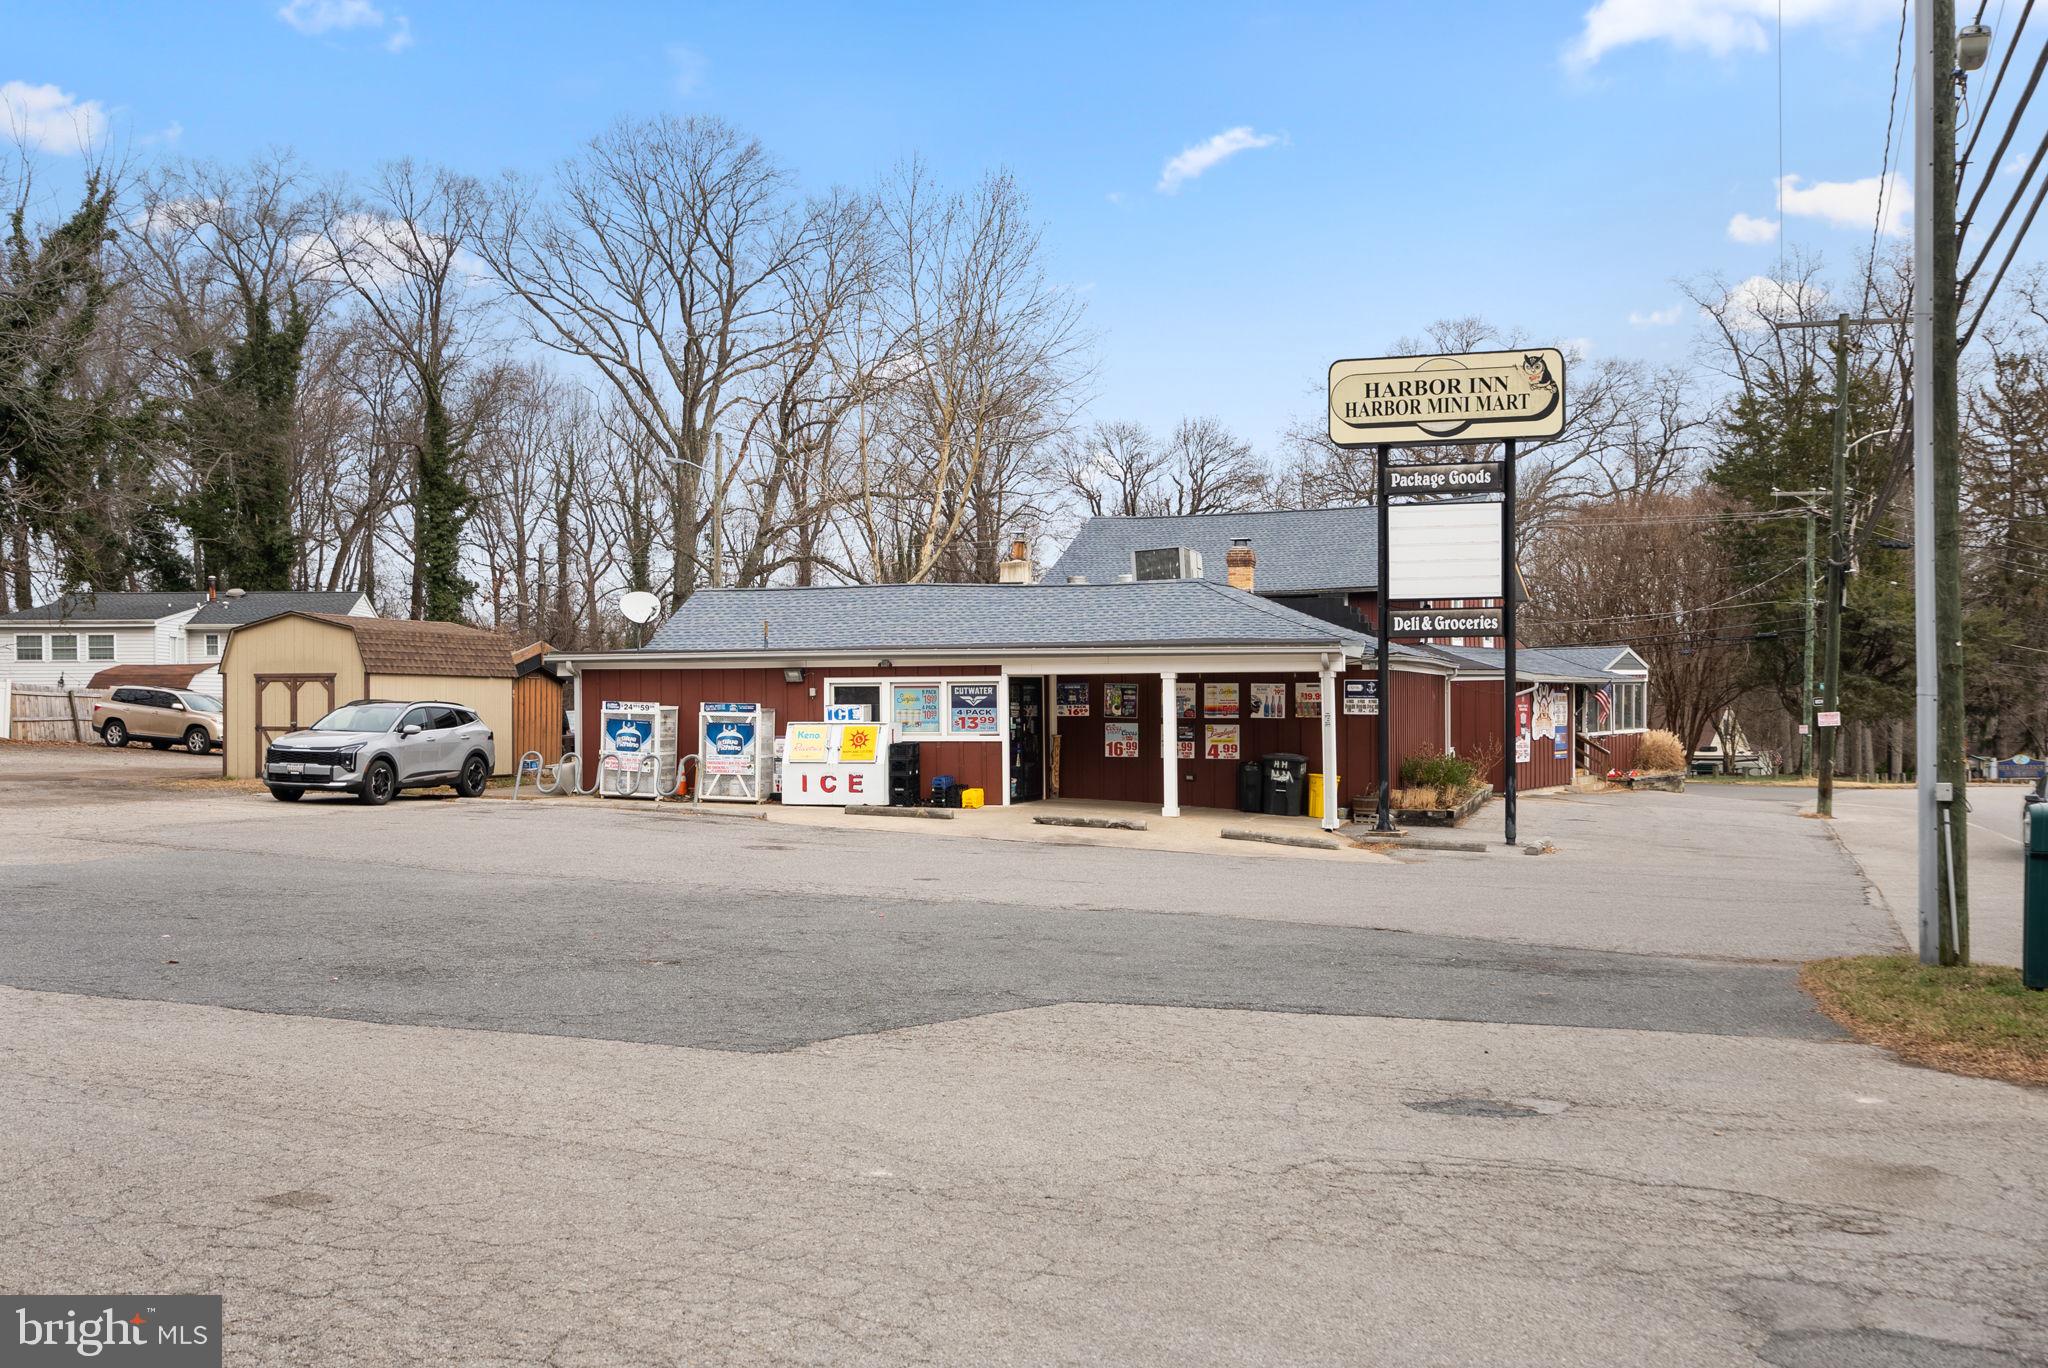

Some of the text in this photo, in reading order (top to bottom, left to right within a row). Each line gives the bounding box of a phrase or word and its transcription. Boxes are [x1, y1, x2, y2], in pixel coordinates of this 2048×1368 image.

[1364, 375, 1509, 399] HARBOR INN
[1345, 393, 1530, 418] HARBOR MINI MART
[1391, 469, 1492, 489] Package Goods
[1393, 616, 1420, 632] Deli
[1434, 614, 1499, 631] Groceries
[954, 687, 993, 695] CUTWATER
[827, 707, 861, 721] ICE
[797, 731, 820, 740] Keno
[1106, 741, 1138, 757] 16.99
[1207, 744, 1238, 759] 4.99
[801, 774, 864, 794] ICE
